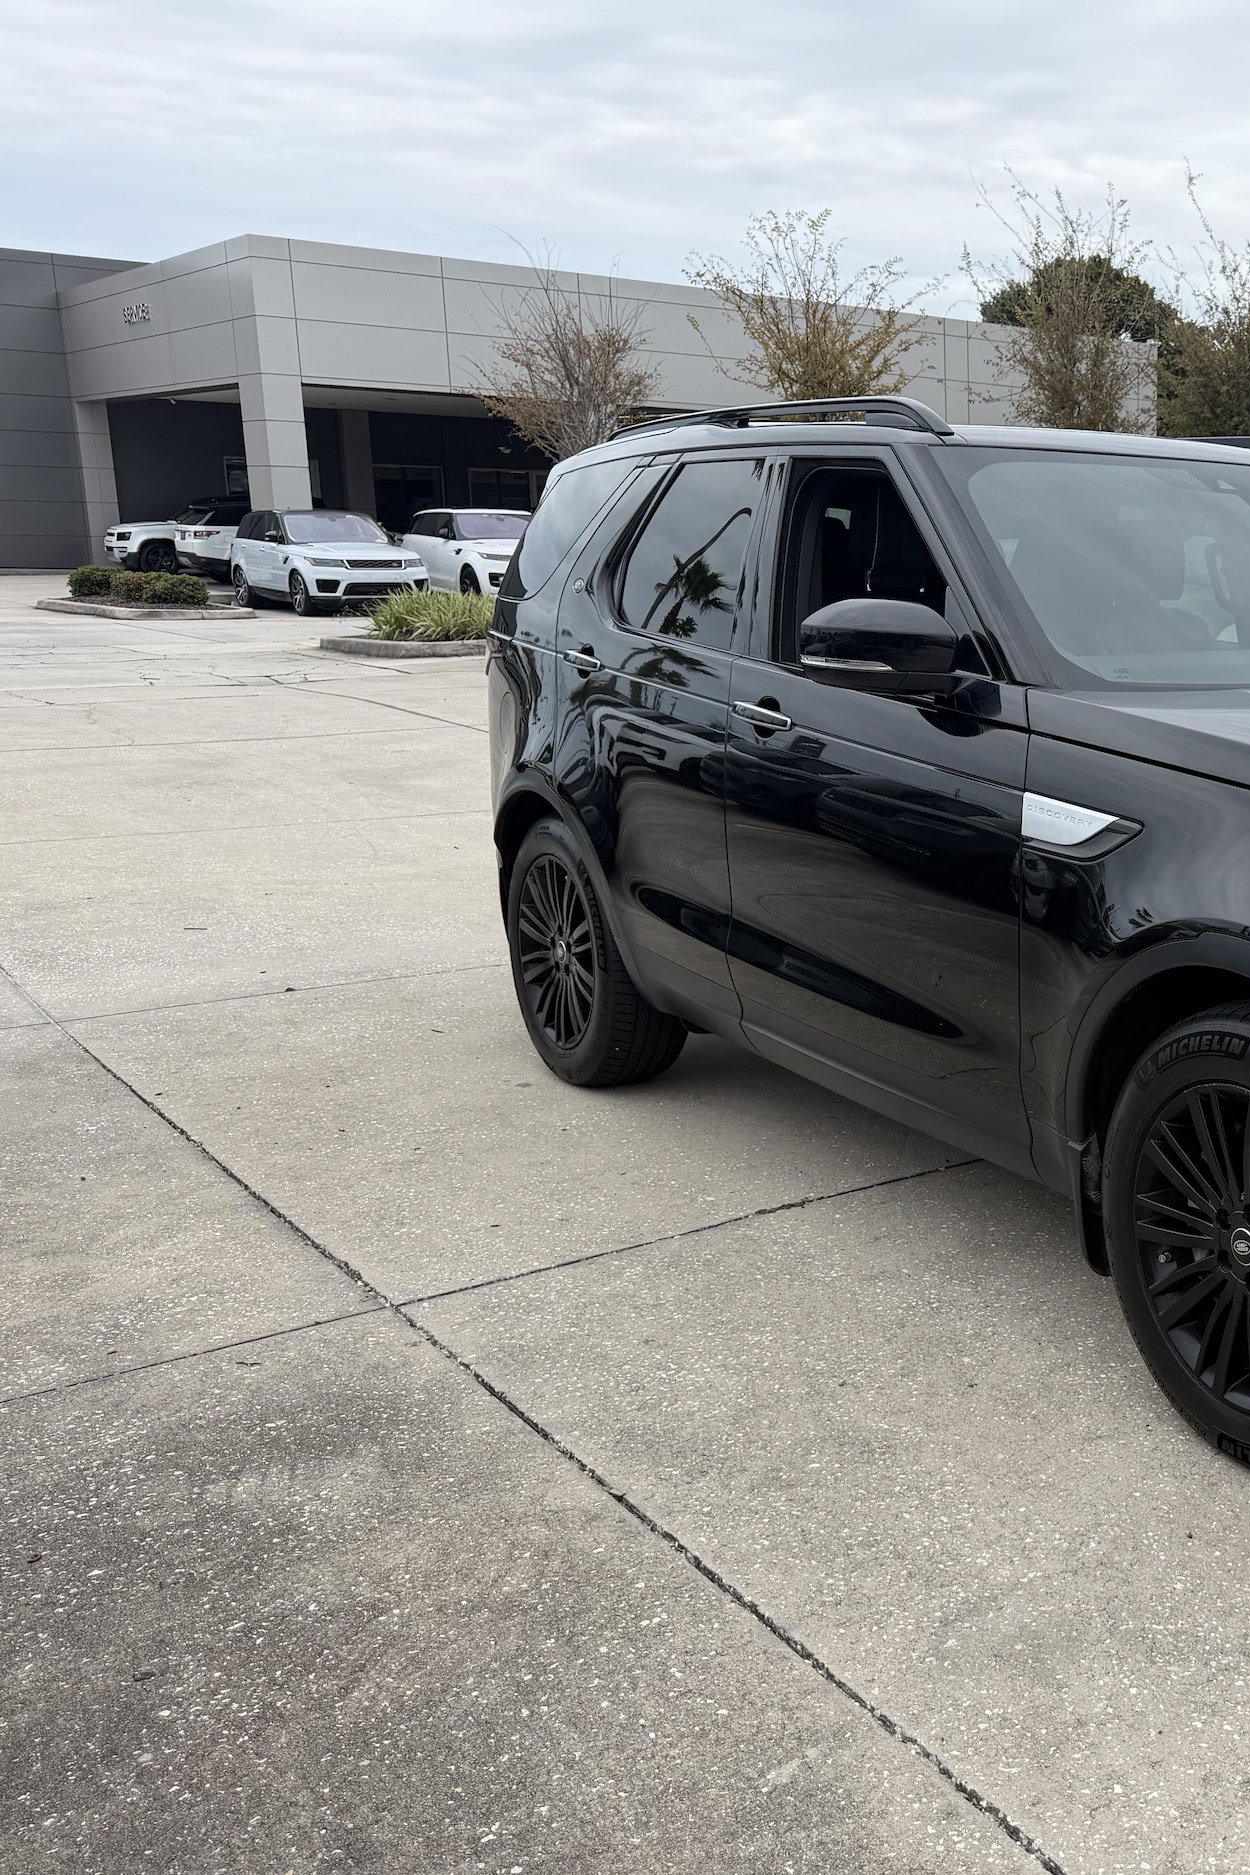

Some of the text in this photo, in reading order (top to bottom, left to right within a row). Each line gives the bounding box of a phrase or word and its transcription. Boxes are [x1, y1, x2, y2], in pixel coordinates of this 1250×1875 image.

[1026, 804, 1093, 827] DISCOVERY
[1157, 1034, 1247, 1068] MICHELIN
[1178, 1407, 1208, 1438] PILOT
